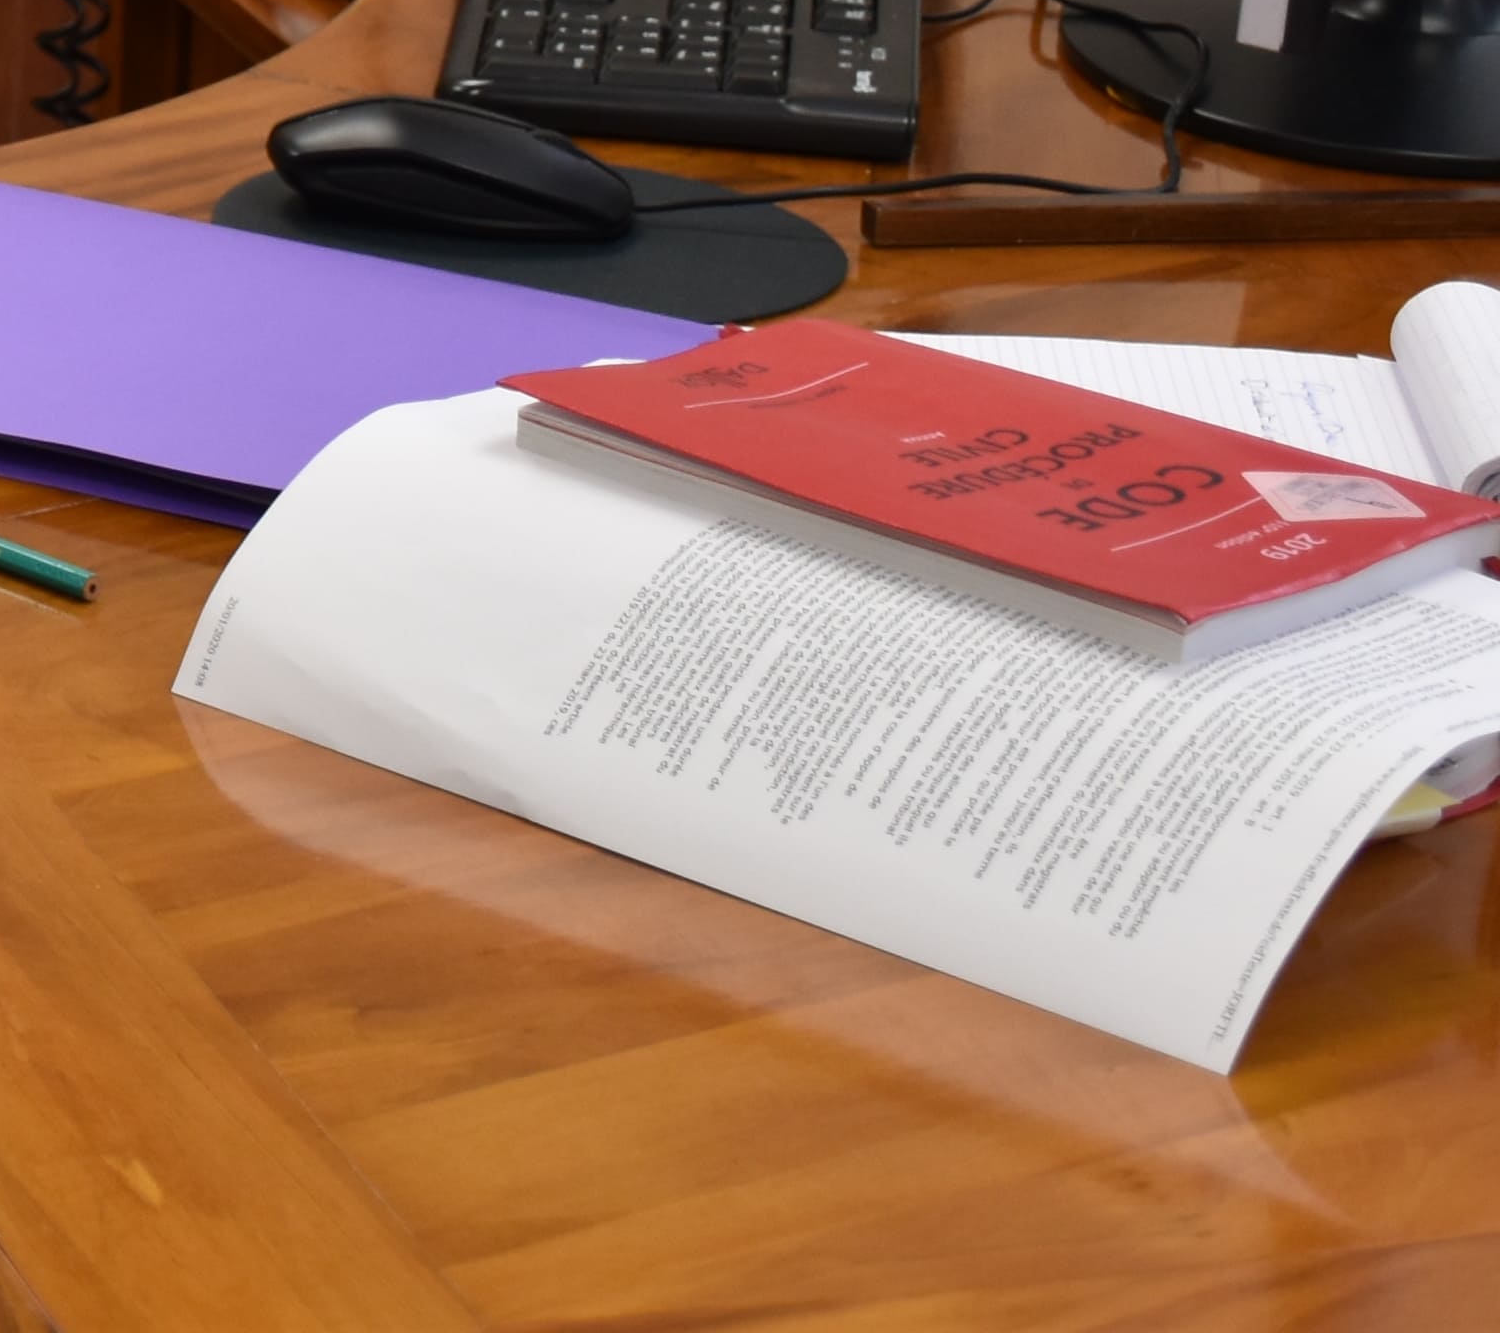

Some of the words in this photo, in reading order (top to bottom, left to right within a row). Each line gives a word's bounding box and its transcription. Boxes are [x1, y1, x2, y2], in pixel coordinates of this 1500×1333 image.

[899, 428, 1030, 467] CIVILE
[906, 422, 1145, 501] PROCÉDURE
[1037, 463, 1224, 532] CODE
[1060, 478, 1097, 491] DE
[1259, 532, 1328, 561] 2019
[204, 595, 239, 656] 20/01/2020
[642, 582, 684, 634] juridiction
[784, 603, 810, 632] Paris.
[192, 656, 213, 688] 14:08
[604, 629, 650, 686] considérée.
[626, 622, 669, 675] juridiction.
[635, 646, 666, 684] niveau
[690, 643, 731, 694] tribunaux
[754, 637, 798, 691] judiciaires
[792, 635, 849, 706] vice-président
[578, 662, 611, 705] présent
[628, 668, 667, 719] rattachés.
[745, 672, 789, 727] détention,
[764, 663, 812, 723] contentieux
[883, 677, 913, 711] grade.
[930, 655, 965, 695] ressort.
[1015, 662, 1064, 716] temporaire.
[551, 686, 582, 720] 2019,
[555, 701, 586, 740] article.
[594, 680, 644, 747] hiérarchique
[645, 711, 669, 742] leurs
[655, 690, 699, 746] judiciaires
[699, 681, 736, 726] pendant
[718, 701, 753, 746] premier
[768, 701, 801, 740] chargé
[625, 706, 658, 750] tribunal
[662, 707, 703, 761] magistrat
[713, 722, 754, 778] procureur
[761, 707, 812, 774] l'instruction,
[1055, 714, 1107, 777] changement
[667, 745, 694, 780] durée
[763, 737, 808, 797] juridiction,
[767, 756, 811, 817] magistrats
[795, 741, 836, 795] intervient
[850, 742, 884, 785] d'appel
[874, 752, 911, 796] emplois
[923, 731, 975, 799] hiérarchique
[1177, 767, 1207, 801] congé
[1233, 748, 1277, 798] remplacer
[931, 772, 963, 812] alinéas
[976, 761, 1021, 819] prononcée
[1010, 772, 1064, 843] d'affectation,
[882, 792, 917, 839] tribunal
[900, 795, 932, 835] auquel
[947, 794, 981, 838] précise
[991, 798, 1029, 848] jusqu'au
[1030, 803, 1077, 866] contentieux
[1080, 805, 1110, 839] mois,
[1152, 798, 1184, 838] annuel.
[1177, 793, 1241, 878] temporairement
[971, 844, 1000, 882] terme
[1067, 836, 1090, 862] être
[1157, 836, 1194, 885] trouvent
[1013, 864, 1038, 896] dans
[1018, 850, 1063, 913] magistrats
[1067, 890, 1090, 916] leur
[1097, 861, 1124, 896] durée
[1126, 854, 1164, 905] adoption
[1122, 882, 1164, 942] empêchés
